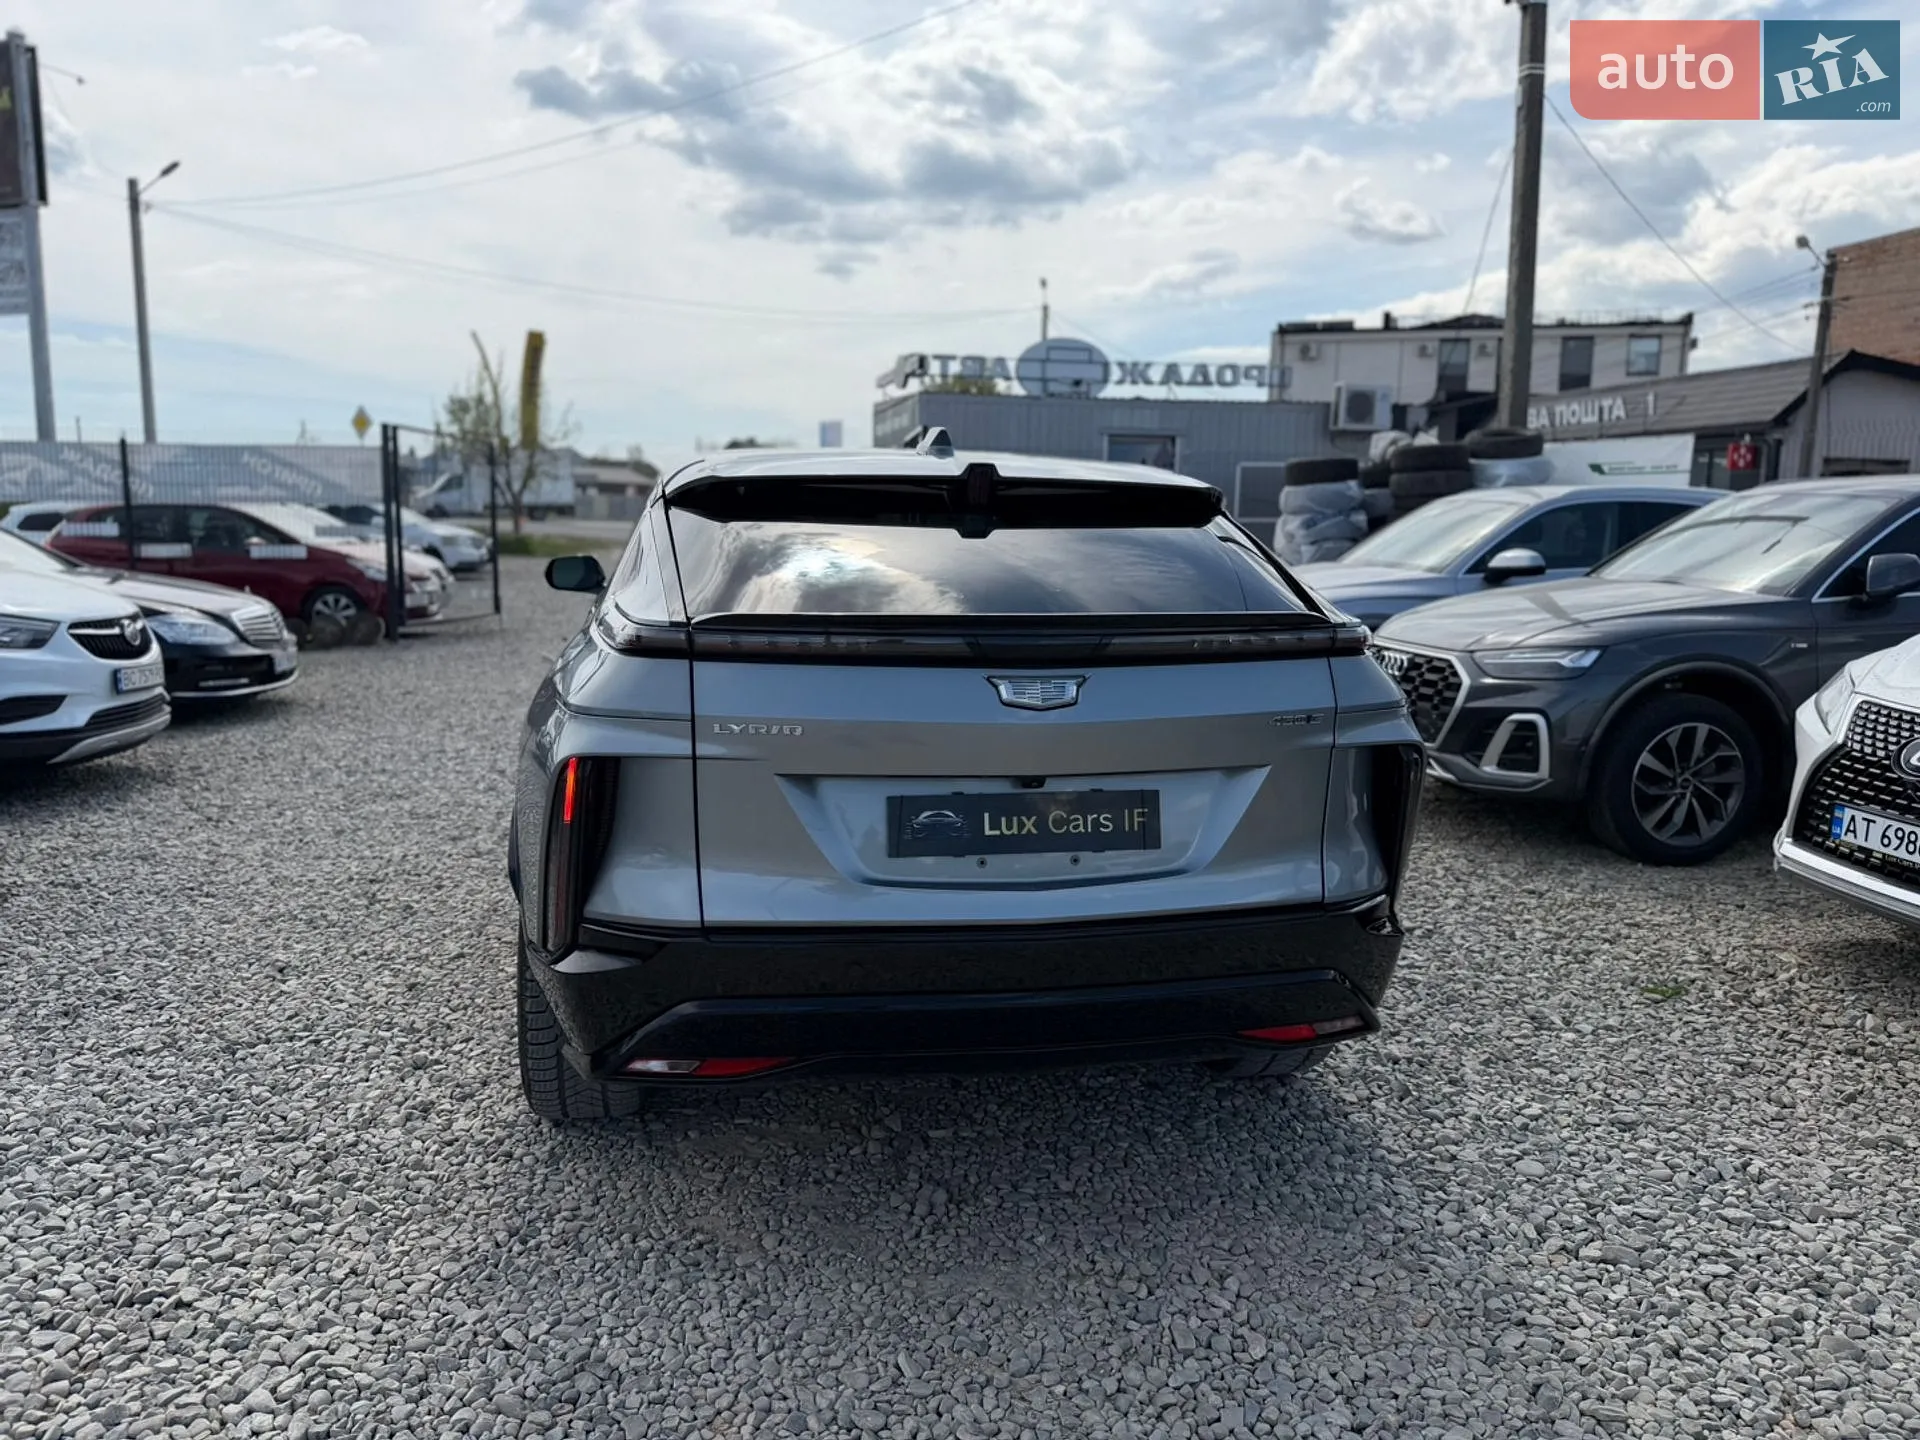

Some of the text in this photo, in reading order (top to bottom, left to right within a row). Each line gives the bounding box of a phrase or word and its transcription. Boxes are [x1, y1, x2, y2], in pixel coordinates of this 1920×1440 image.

[1526, 405, 1551, 430] ВА
[1555, 394, 1627, 428] ПОШТА
[712, 721, 804, 737] LYRIQ
[983, 807, 1149, 837] Lux Cars IF
[1843, 814, 1920, 856] AT 698
